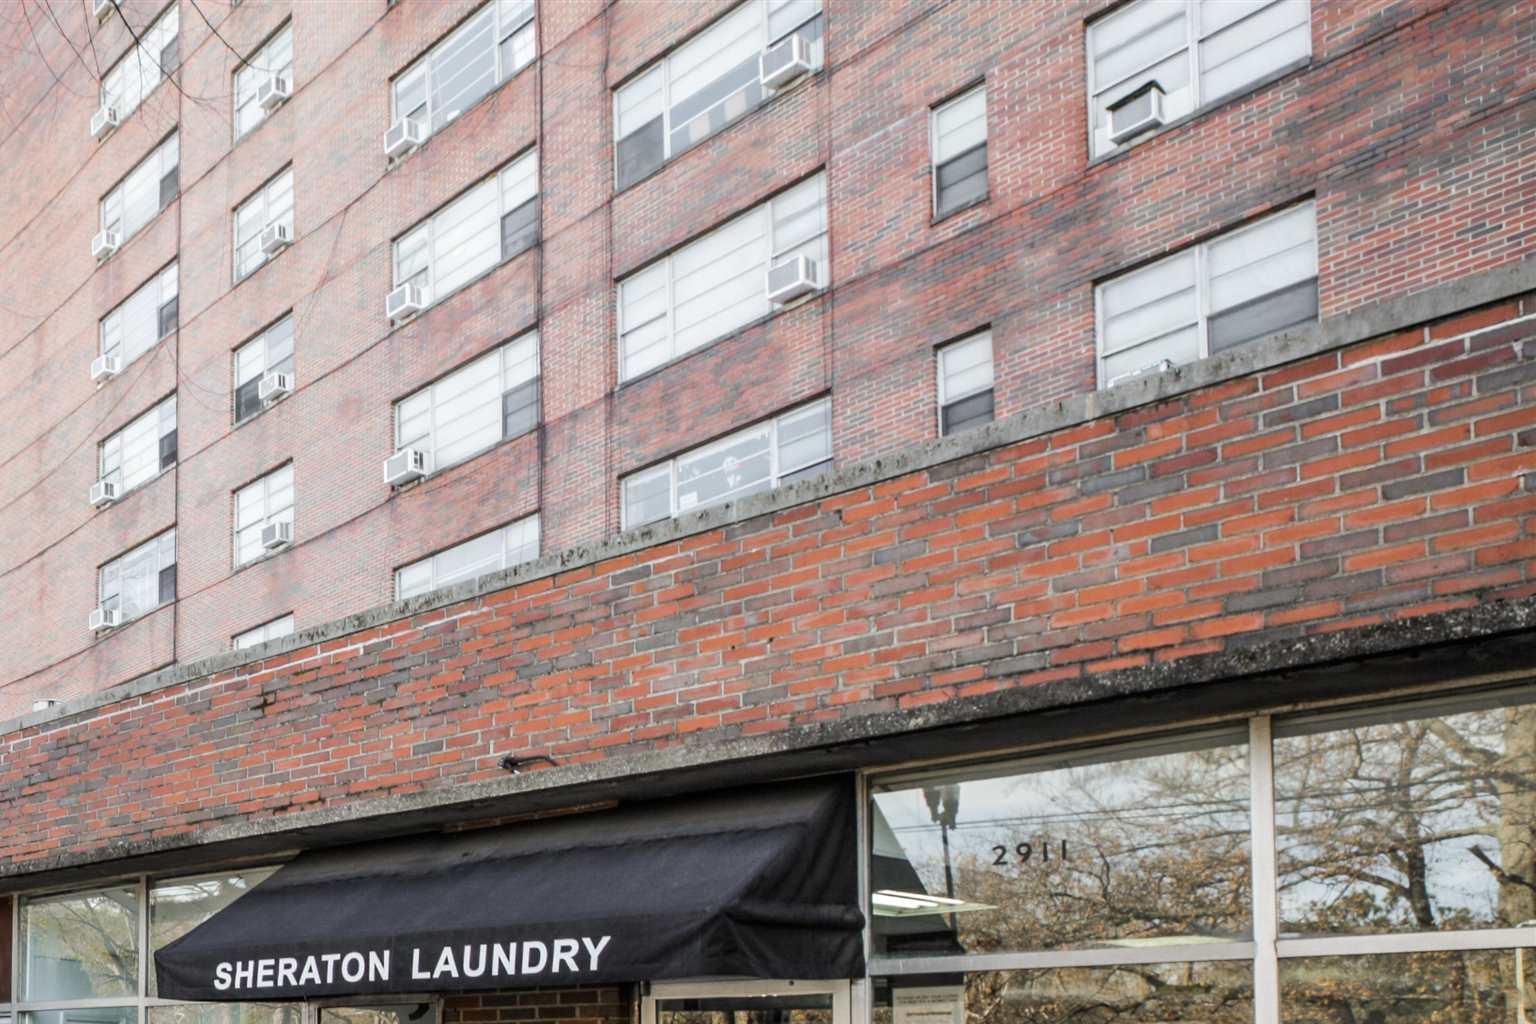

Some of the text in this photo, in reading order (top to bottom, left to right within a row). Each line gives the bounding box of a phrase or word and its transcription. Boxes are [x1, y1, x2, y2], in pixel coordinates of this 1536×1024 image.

[992, 839, 1067, 866] 2911
[214, 936, 611, 991] SHERATON LAUNDRY
